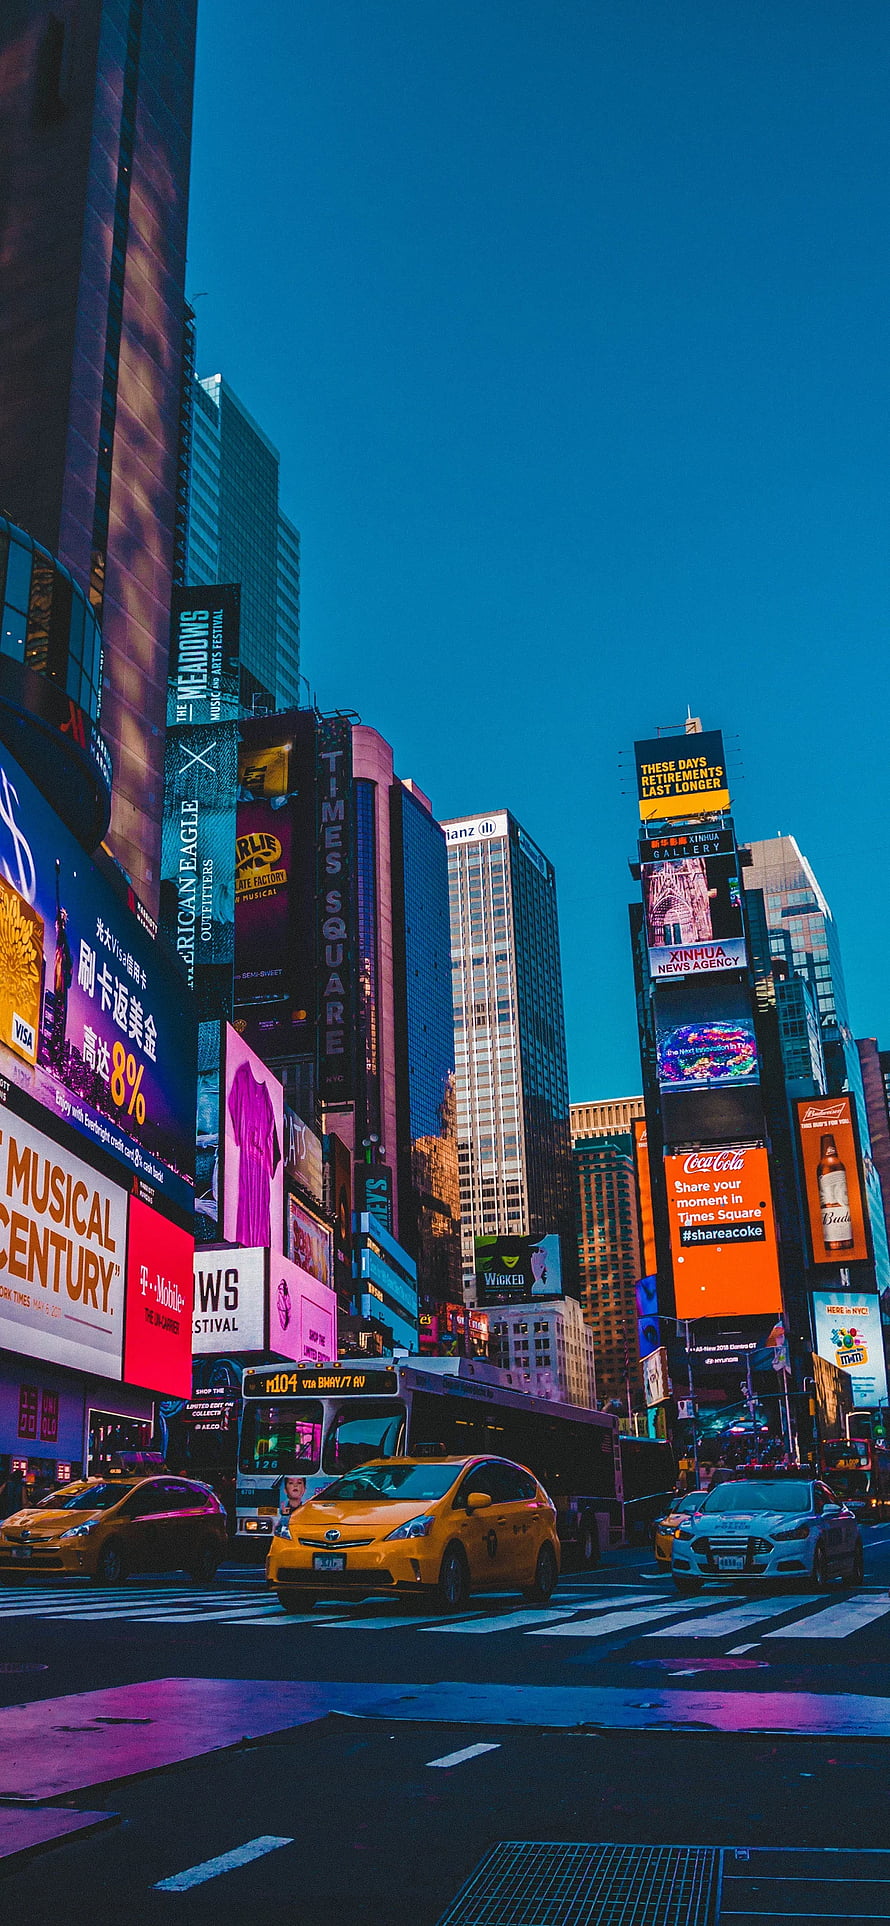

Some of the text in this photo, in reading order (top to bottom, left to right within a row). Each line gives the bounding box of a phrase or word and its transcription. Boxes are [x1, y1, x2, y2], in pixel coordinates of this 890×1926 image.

[212, 609, 224, 649] FESTIVAL
[176, 610, 209, 723] THE MEADOWS
[211, 654, 222, 675] ARTS
[210, 692, 221, 720] MUSIC
[640, 757, 707, 776] THESE DAYS
[641, 766, 724, 787] RETIREMENTS
[642, 778, 721, 798] LAST LONGER
[689, 832, 720, 843] XINHUA
[653, 842, 720, 859] GALLERY
[253, 872, 285, 888] FACTORY
[177, 800, 198, 991] ERICAN EAGLE
[201, 859, 213, 941] OUTFITTERS
[242, 888, 278, 903] MUSICAL
[321, 750, 347, 1056] TIMES SQUARE
[669, 945, 726, 963] XINHUA
[658, 957, 740, 975] NEWS AGENCY
[78, 938, 158, 1062] 刷卡返美金
[14, 1018, 33, 1051] VISA
[680, 1047, 695, 1055] Next
[695, 1044, 730, 1054] Innovation
[83, 1025, 146, 1125] 高达8%
[56, 1090, 72, 1117] Enjoy
[71, 1105, 84, 1124] with
[84, 1113, 111, 1144] Everbright
[110, 1136, 124, 1154] credit
[124, 1146, 135, 1161] card
[6, 1136, 116, 1253] MUSICAL
[675, 1180, 742, 1193] Share your
[676, 1194, 743, 1208] moment in
[677, 1208, 762, 1223] Times Square
[683, 1225, 763, 1242] #shareacoke
[13, 1290, 31, 1308] TIMES
[192, 1267, 240, 1313] WS
[826, 1306, 844, 1314] HERE
[852, 1307, 869, 1315] NYC!
[191, 1318, 239, 1335] STIVAL
[266, 1374, 366, 1393] M104 VIA BWAY/7 AV
